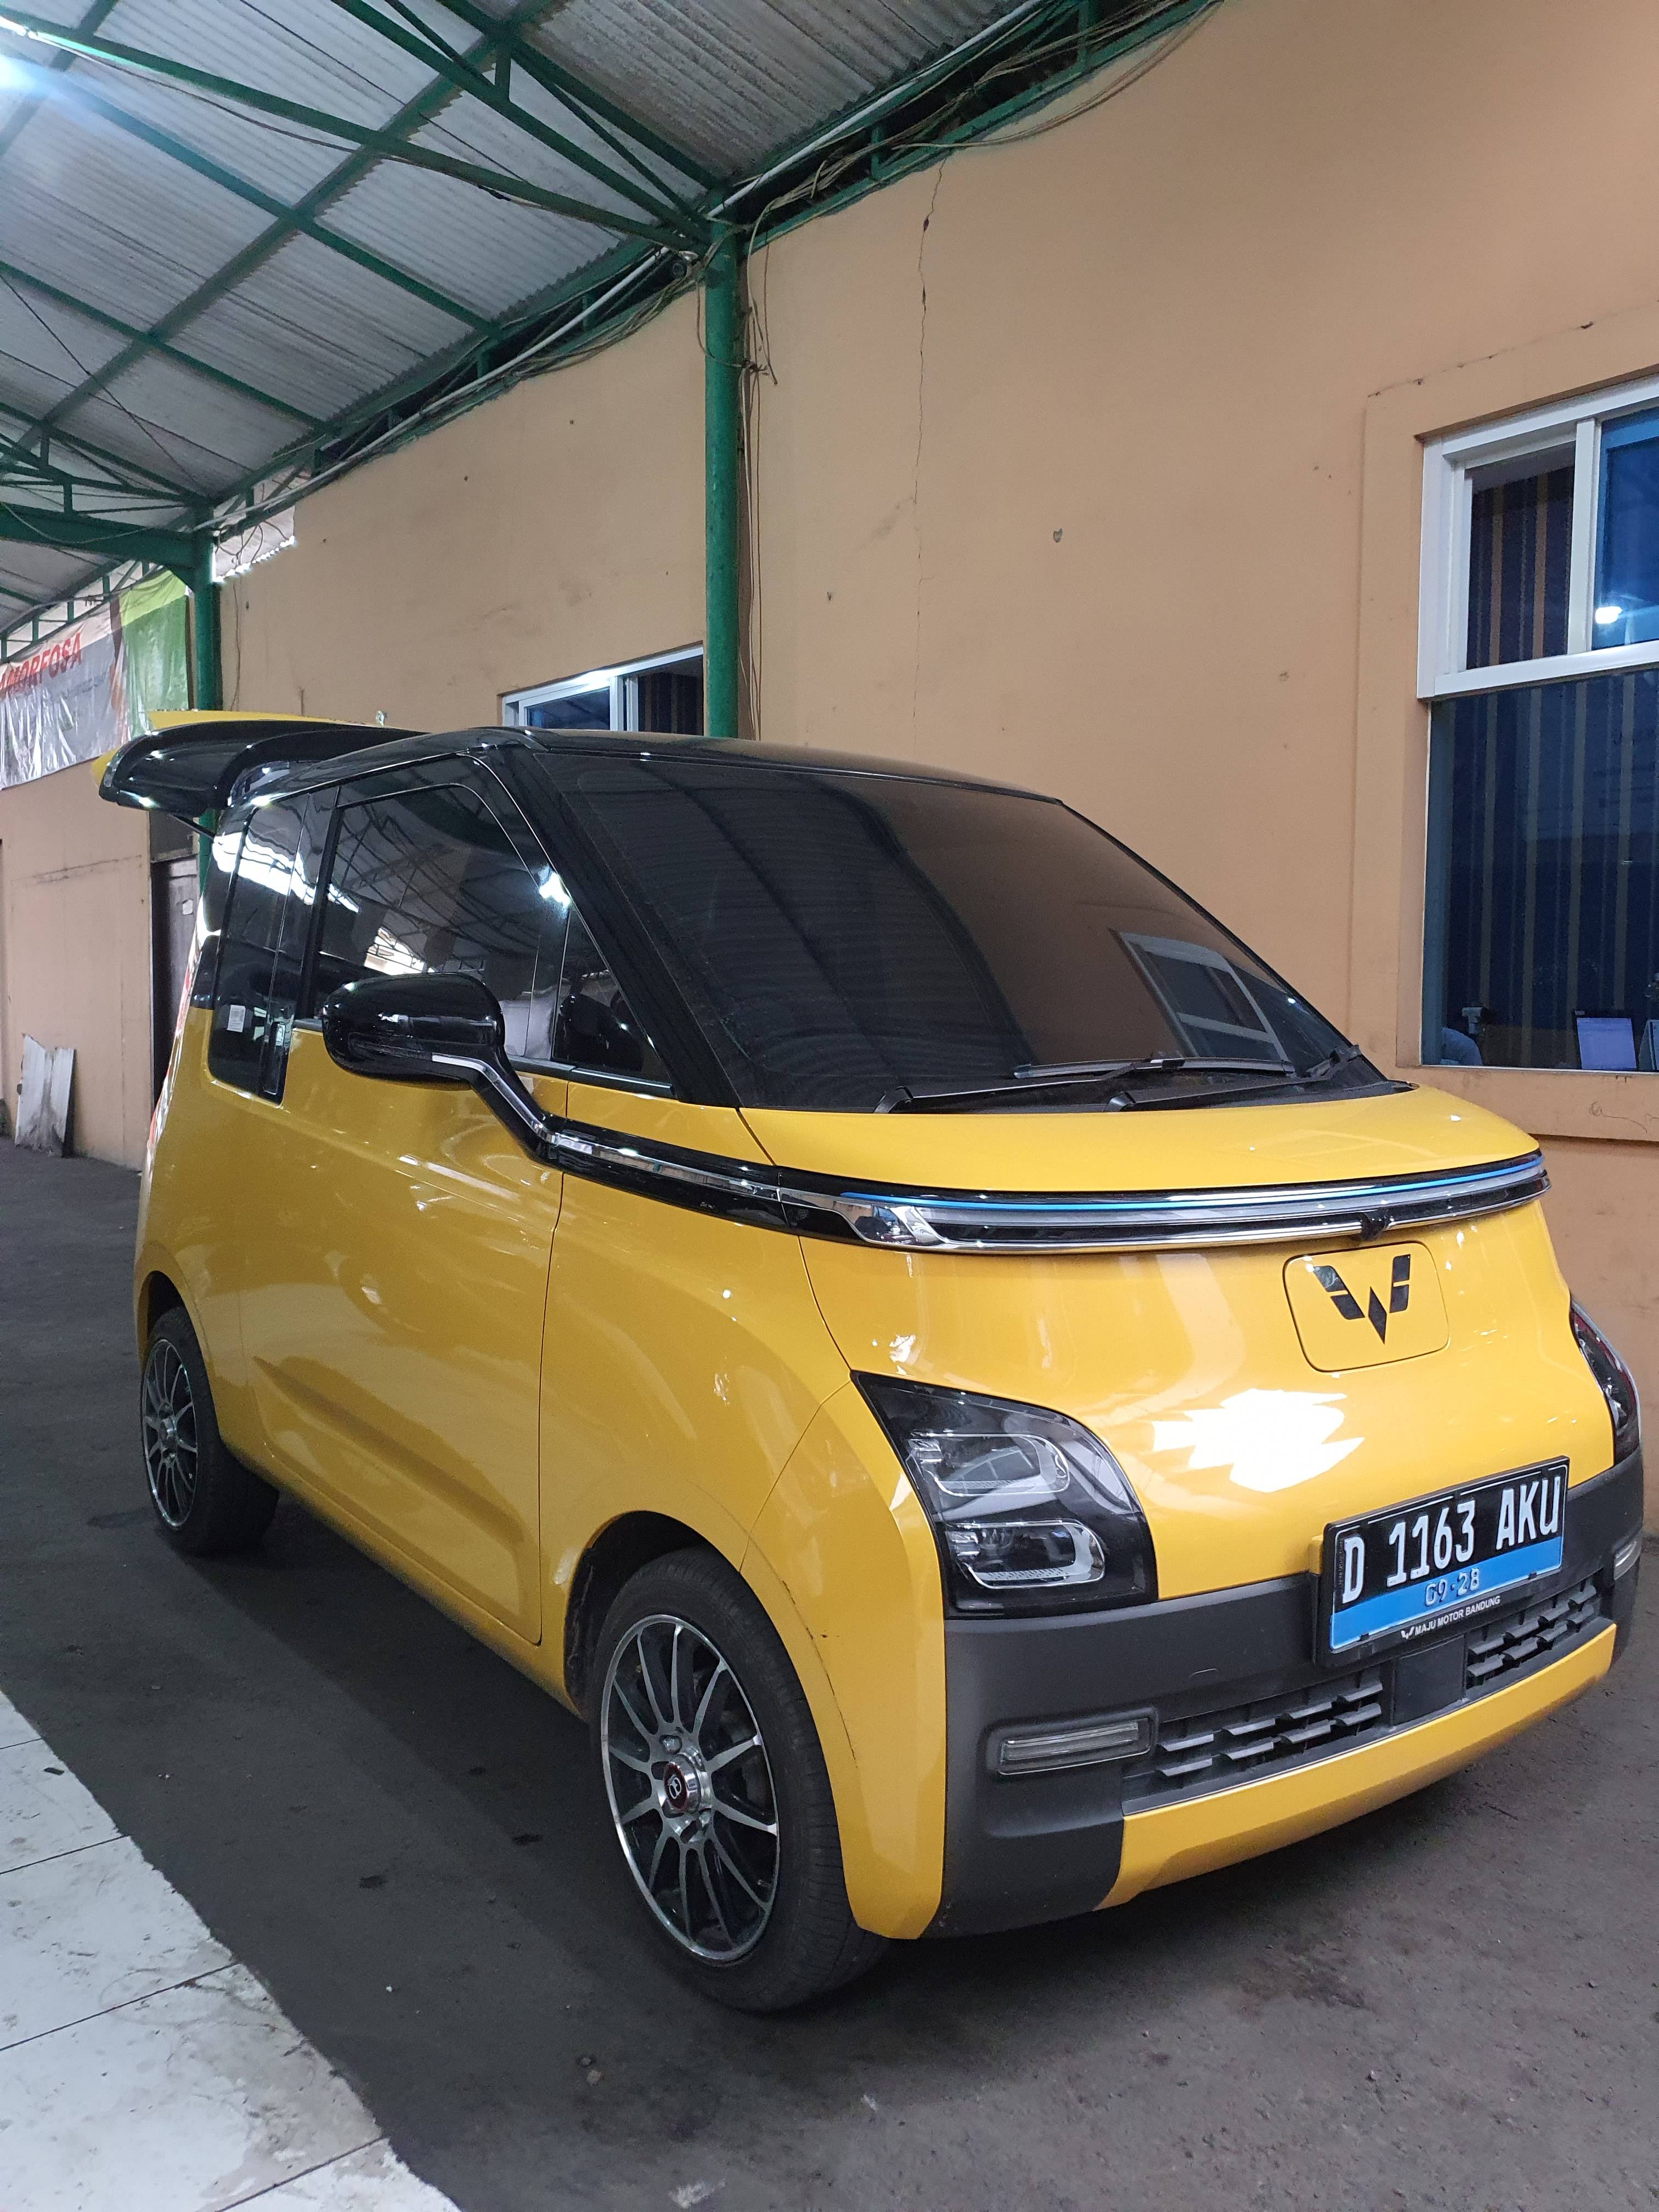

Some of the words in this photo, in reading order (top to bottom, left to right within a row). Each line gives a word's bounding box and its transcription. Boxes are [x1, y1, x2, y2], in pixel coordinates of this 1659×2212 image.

[1342, 1537, 1365, 1604] D
[1386, 1500, 1475, 1587] 1163
[1496, 1476, 1561, 1550] AKU
[1415, 1618, 1436, 1635] MAJU
[1437, 1610, 1464, 1627] MOTOR
[1465, 1595, 1502, 1616] BANDUNG
